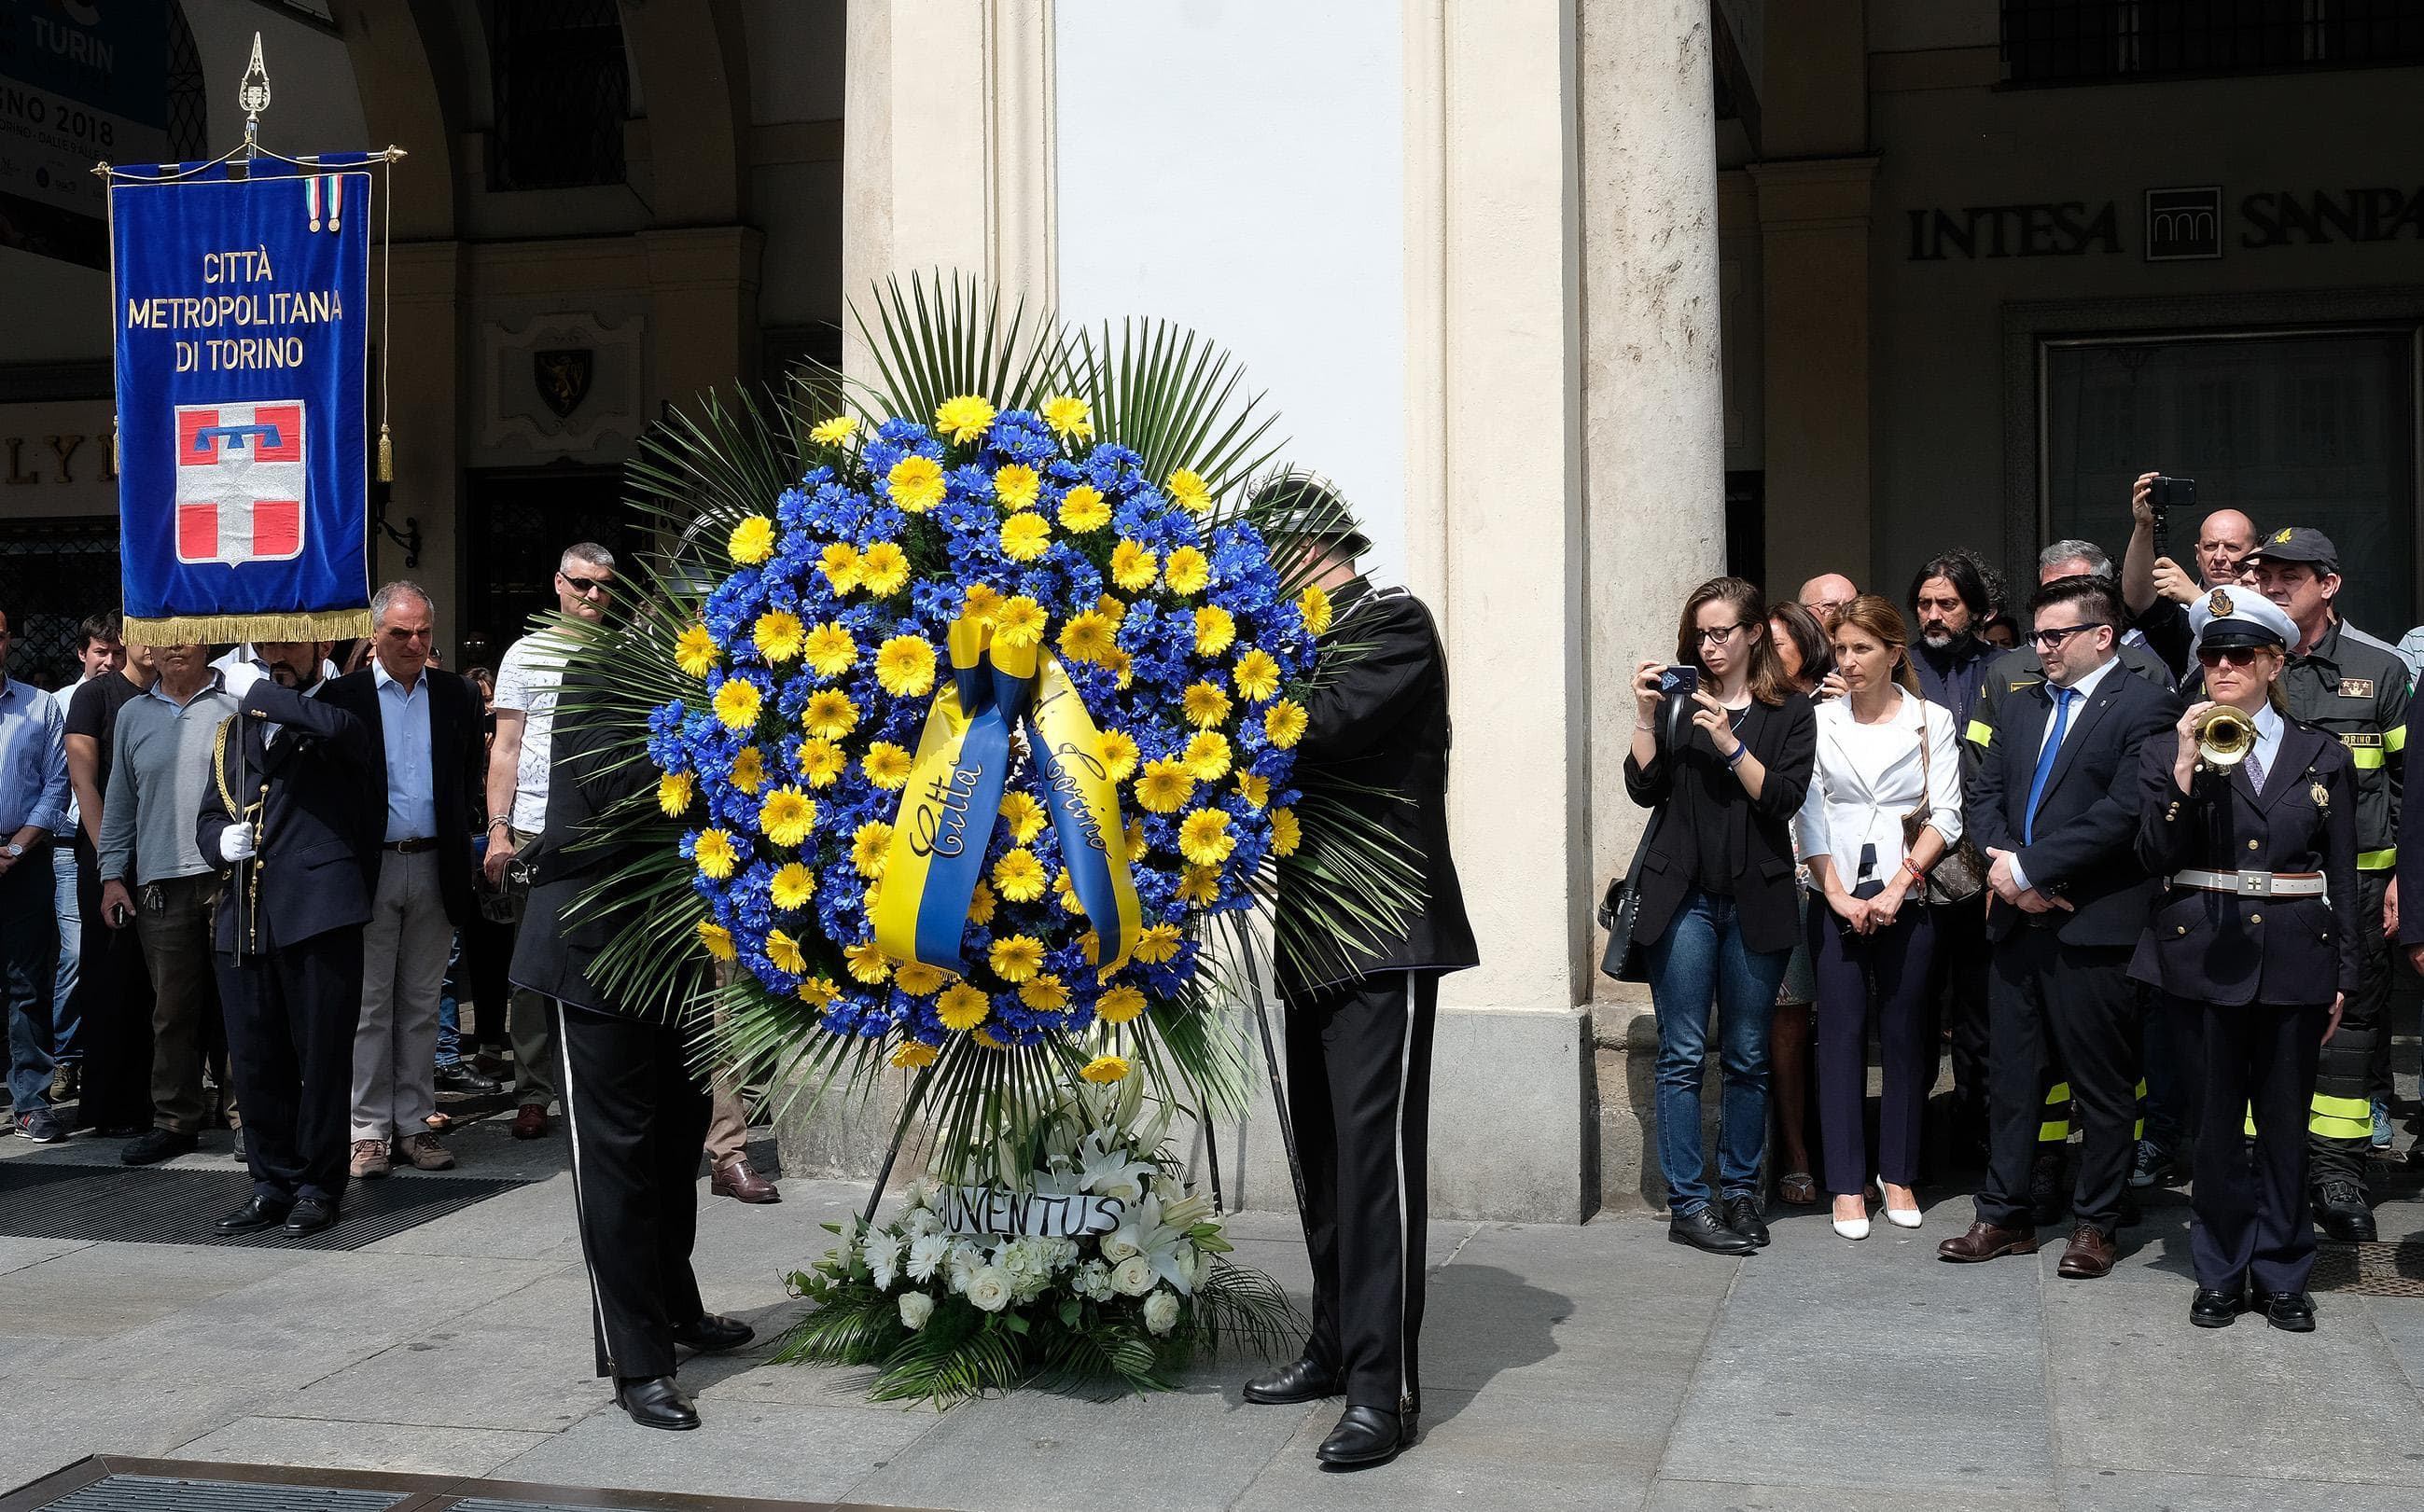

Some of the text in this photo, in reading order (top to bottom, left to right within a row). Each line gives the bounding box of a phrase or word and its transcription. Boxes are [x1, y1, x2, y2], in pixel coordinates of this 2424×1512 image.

[31, 14, 113, 74] TURIN
[0, 86, 114, 146] NO 2018
[1906, 200, 2125, 262] INTESA
[203, 243, 273, 284] CITTÀ
[128, 289, 343, 329] METROPOLITANA
[175, 337, 304, 373] DI TORINO
[2340, 735, 2371, 744] ORINO
